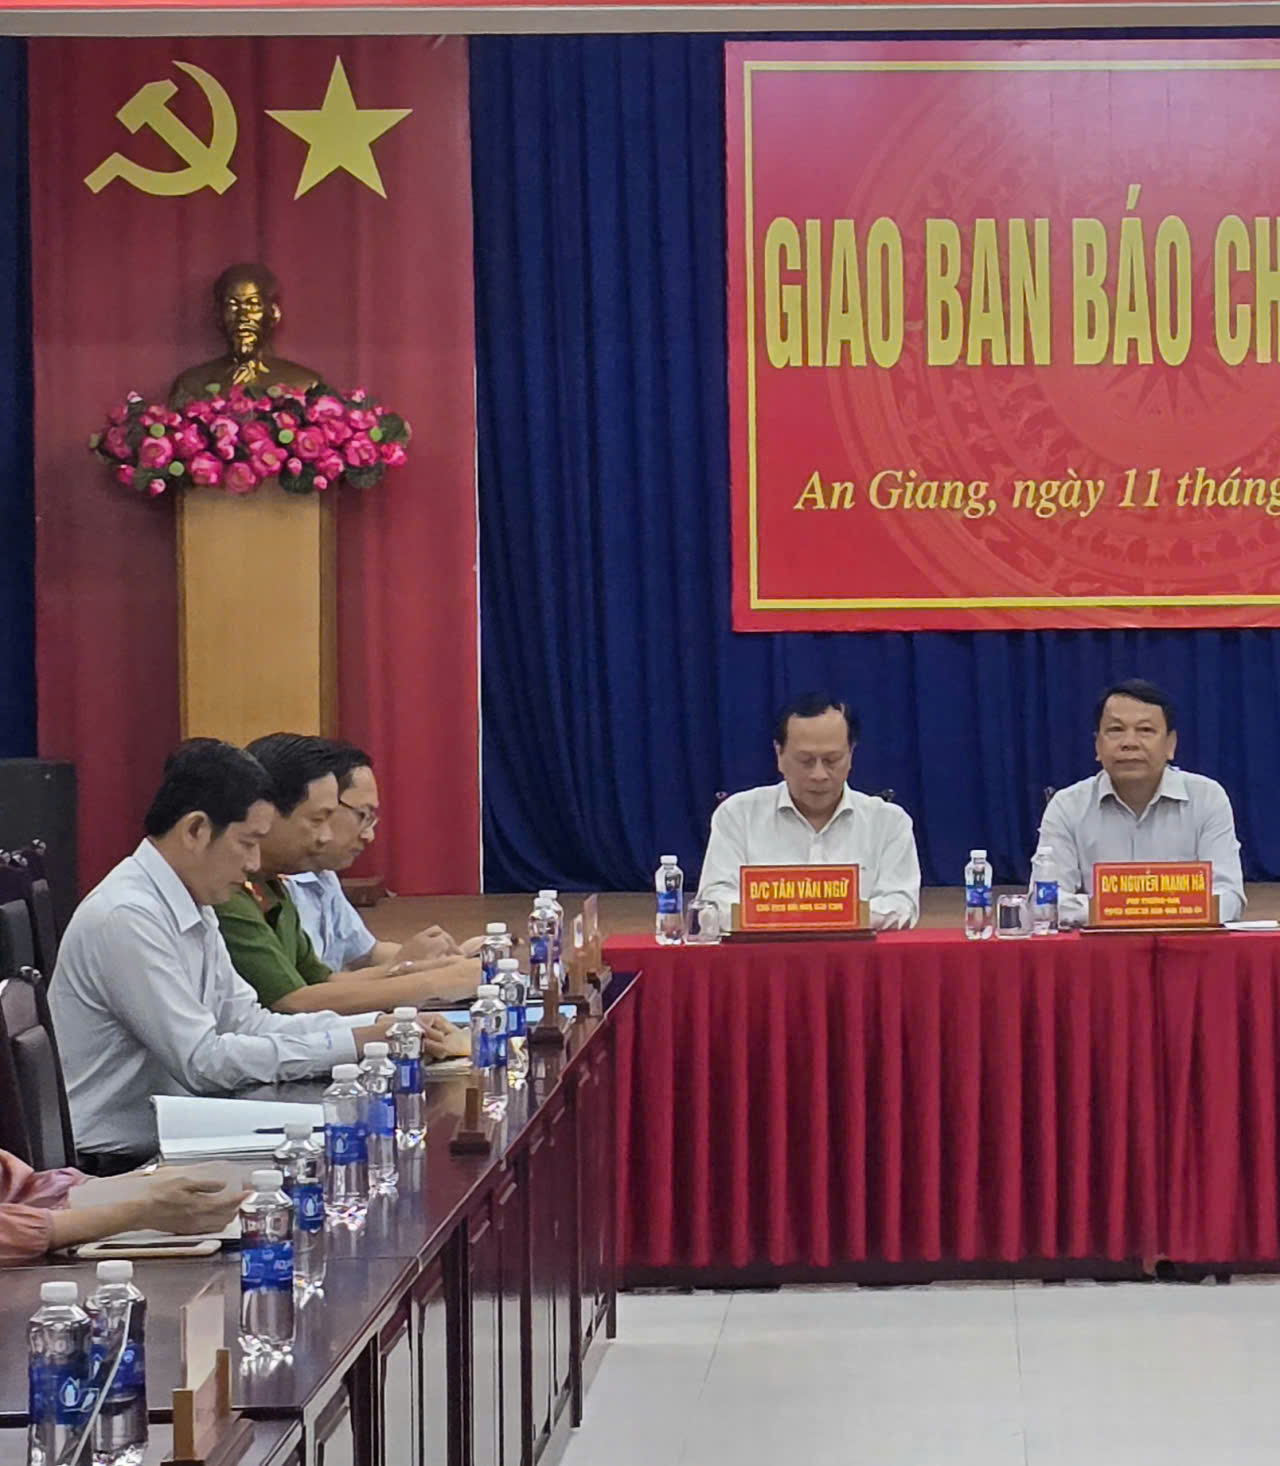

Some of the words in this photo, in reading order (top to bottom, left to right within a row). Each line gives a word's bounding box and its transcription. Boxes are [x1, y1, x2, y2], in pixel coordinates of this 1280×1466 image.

[765, 216, 904, 368] GIAO
[926, 217, 1051, 367] BAN
[1072, 184, 1192, 367] BÁO
[794, 471, 855, 511] An
[868, 471, 998, 518] Giang,
[1012, 467, 1105, 518] ngày
[1121, 469, 1161, 509] 11
